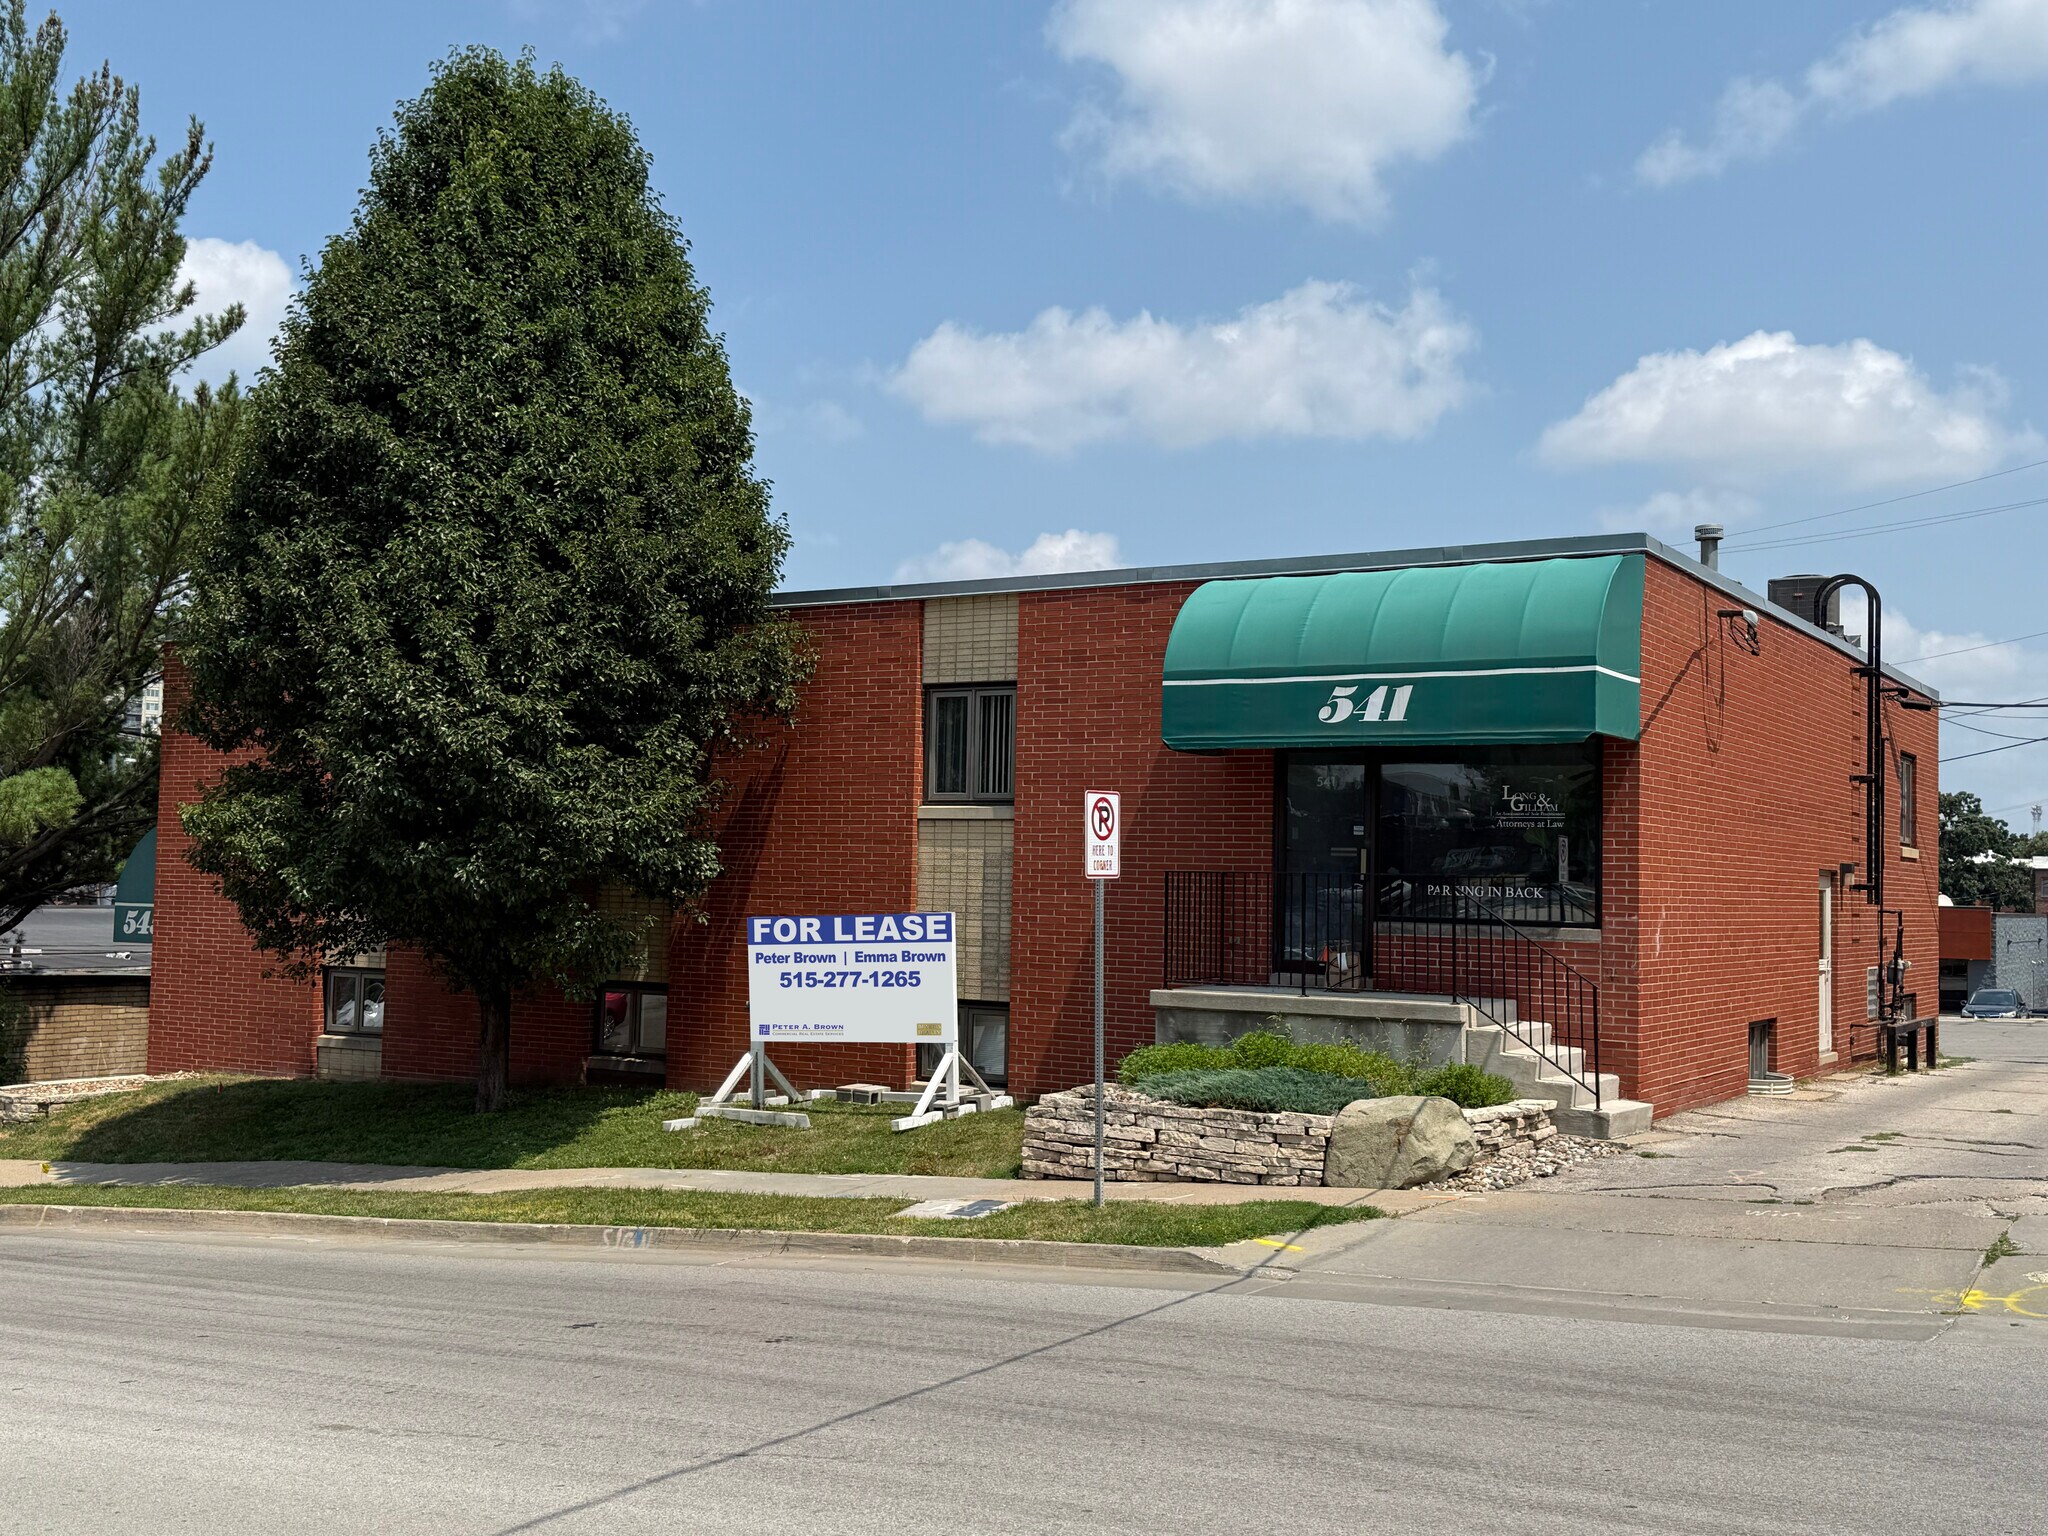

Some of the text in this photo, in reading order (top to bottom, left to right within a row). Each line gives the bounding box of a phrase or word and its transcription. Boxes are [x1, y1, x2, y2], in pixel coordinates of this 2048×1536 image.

[1318, 685, 1413, 723] 541
[1317, 776, 1335, 787] 541
[1496, 820, 1535, 830] Attorneys
[1547, 820, 1565, 828] Law
[1092, 844, 1114, 857] HERE TO
[1093, 860, 1113, 871] CORNER
[1487, 886, 1502, 897] IN
[1505, 886, 1544, 899] BACK
[123, 910, 153, 934] 54
[753, 915, 948, 943] FOR LEASE
[755, 950, 946, 964] Peter Brown Emma Brown
[779, 970, 921, 988] 515-277-1265
